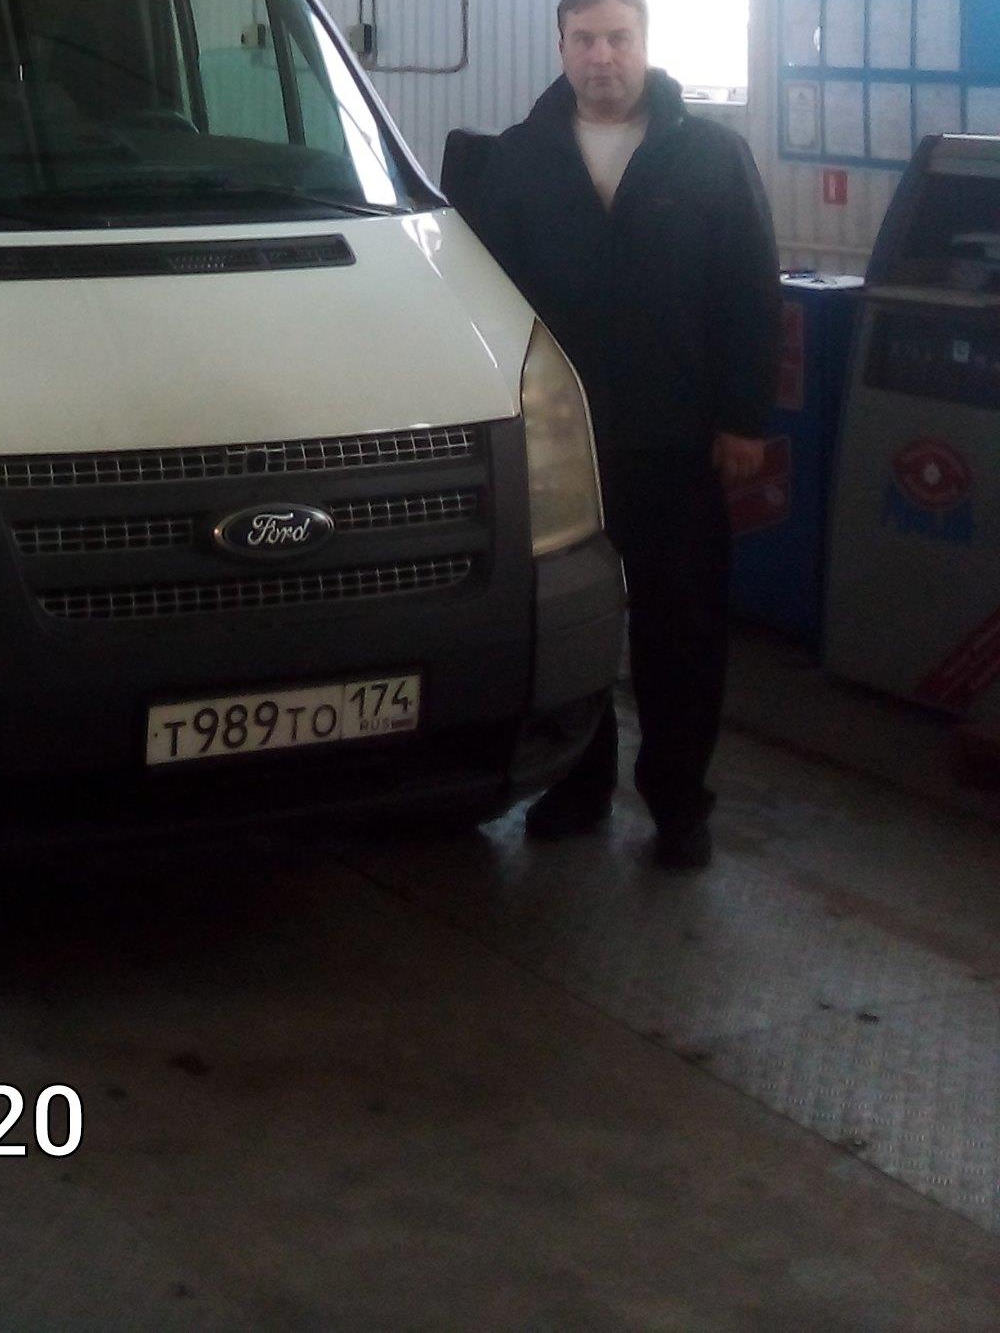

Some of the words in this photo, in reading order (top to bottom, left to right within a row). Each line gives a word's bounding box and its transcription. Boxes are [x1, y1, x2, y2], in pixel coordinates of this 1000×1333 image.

[247, 512, 311, 545] Ford
[349, 680, 410, 718] 174
[359, 719, 391, 733] RUS
